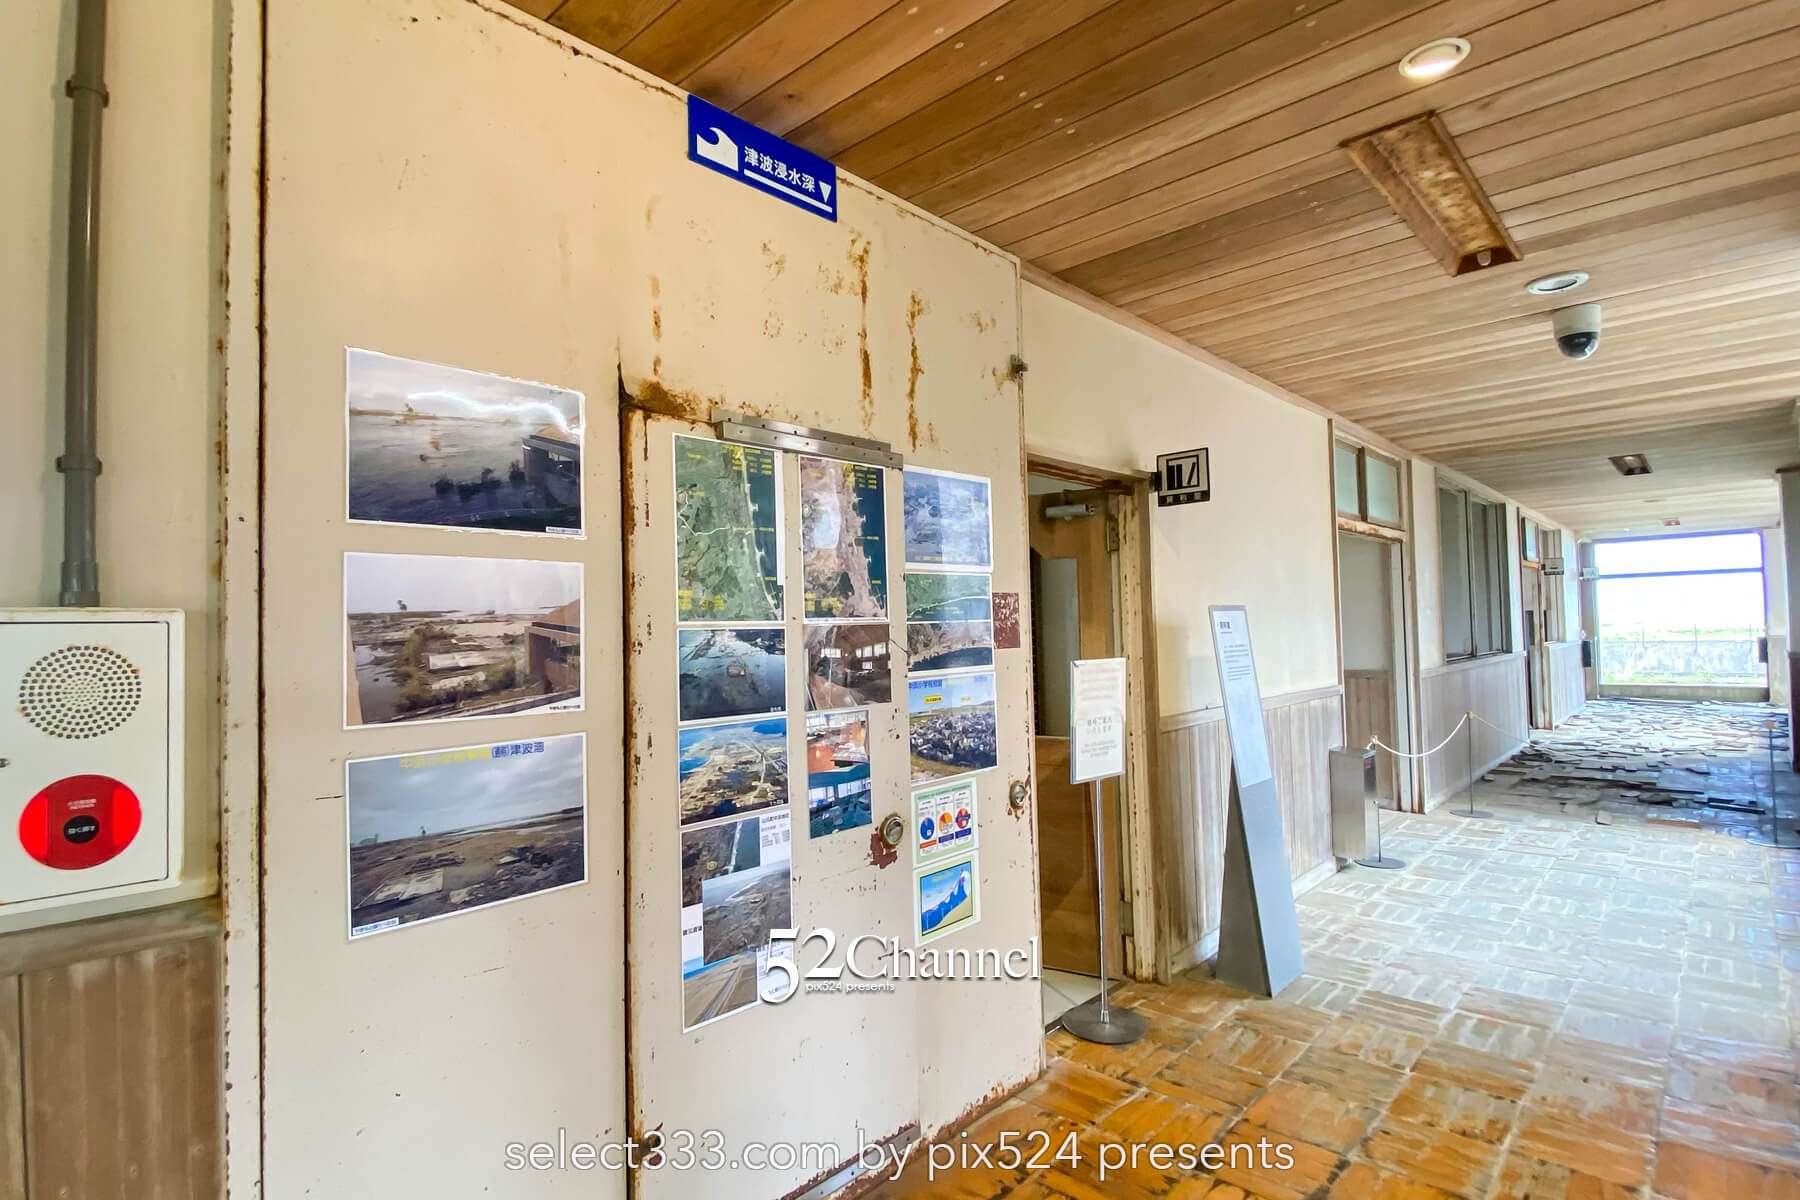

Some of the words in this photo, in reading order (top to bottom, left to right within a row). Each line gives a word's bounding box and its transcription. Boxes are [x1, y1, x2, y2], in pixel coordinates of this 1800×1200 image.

[744, 146, 815, 193] 津波浸水深
